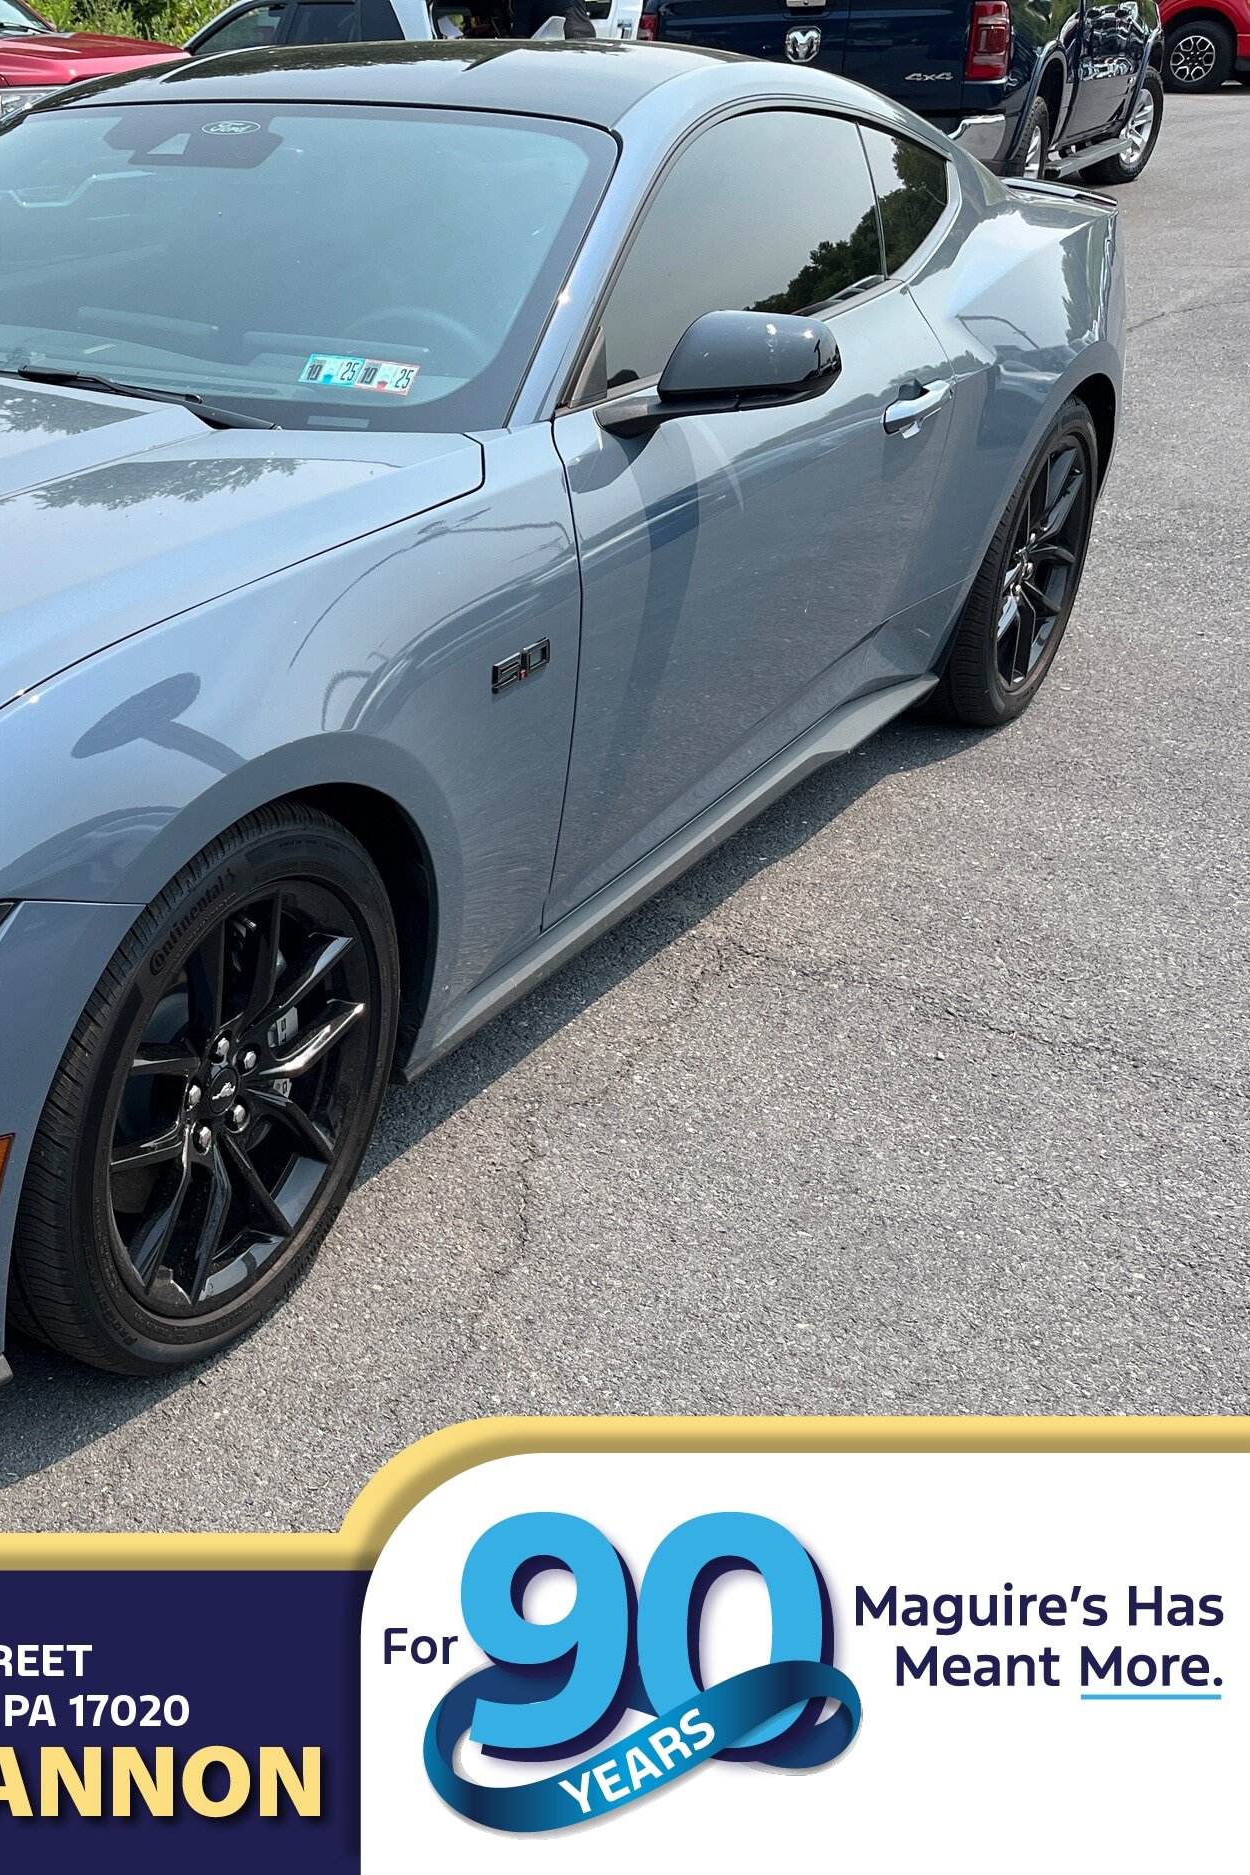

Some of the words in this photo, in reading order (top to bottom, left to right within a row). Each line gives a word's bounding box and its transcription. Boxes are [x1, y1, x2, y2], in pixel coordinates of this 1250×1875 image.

[905, 72, 954, 81] 4x4
[210, 121, 252, 133] Ford
[340, 361, 359, 381] 25
[394, 368, 414, 389] 25
[492, 637, 550, 694] 5.0
[149, 874, 227, 976] Continental
